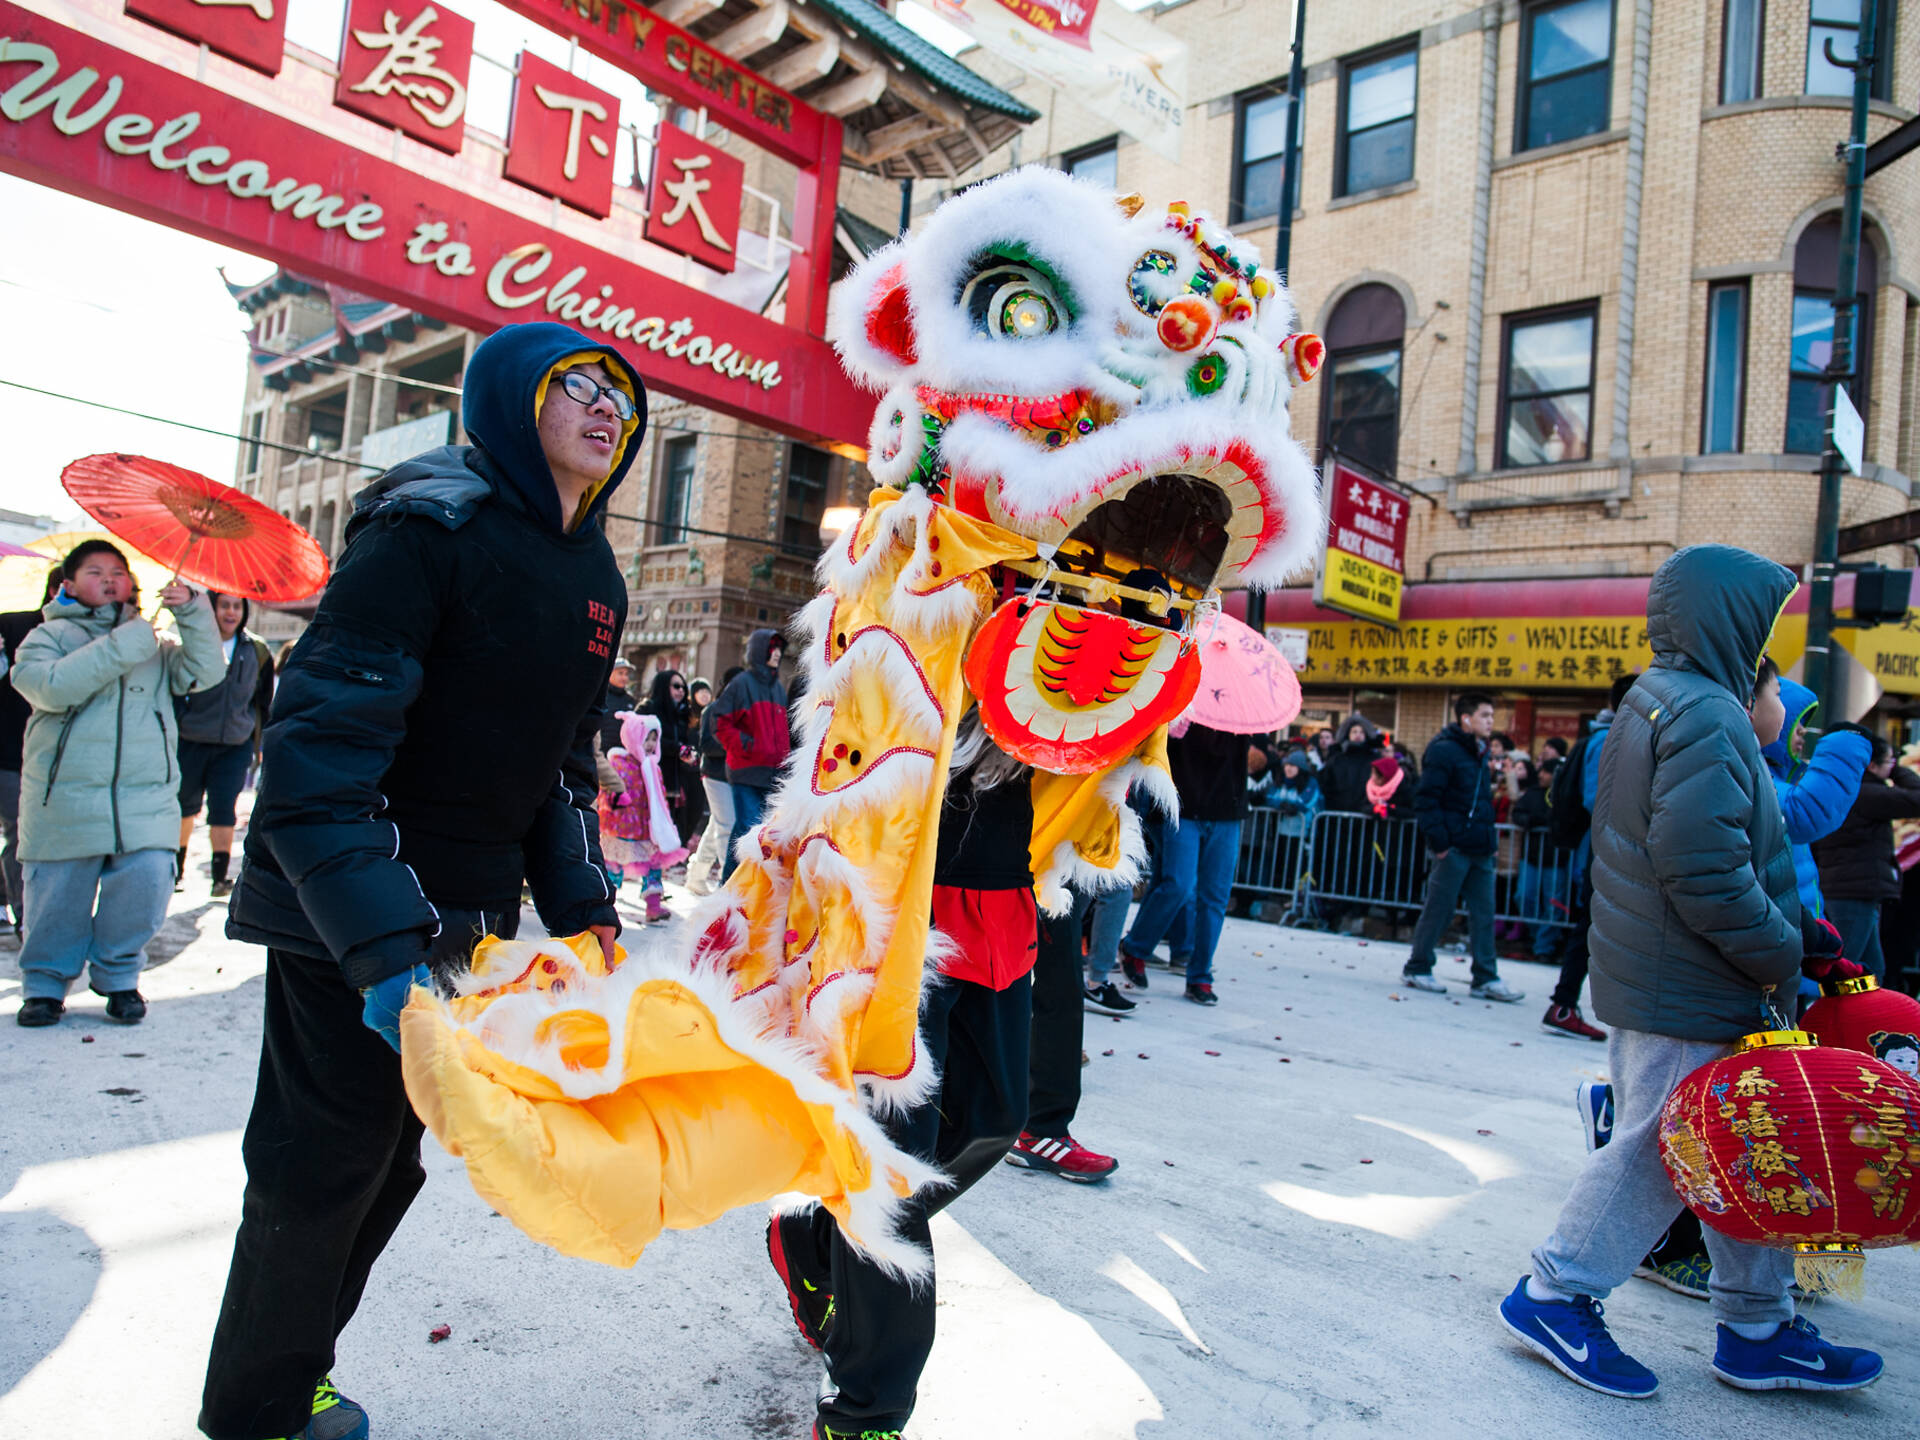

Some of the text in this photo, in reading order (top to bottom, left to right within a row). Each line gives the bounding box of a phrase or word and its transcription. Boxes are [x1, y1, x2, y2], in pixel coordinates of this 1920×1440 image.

[350, 5, 467, 129] 為
[664, 34, 794, 133] CENTER
[533, 83, 610, 182] 下
[0, 36, 385, 242] Welcome
[405, 221, 475, 277] to
[486, 243, 783, 391] Chinatown
[661, 154, 733, 254] 天
[1348, 481, 1403, 525] 太平洋
[1350, 627, 1429, 650] FURNITURE
[1456, 626, 1498, 649] GIFTS
[1525, 626, 1631, 650] WHOLESALE
[1875, 651, 1920, 677] PACIFIC
